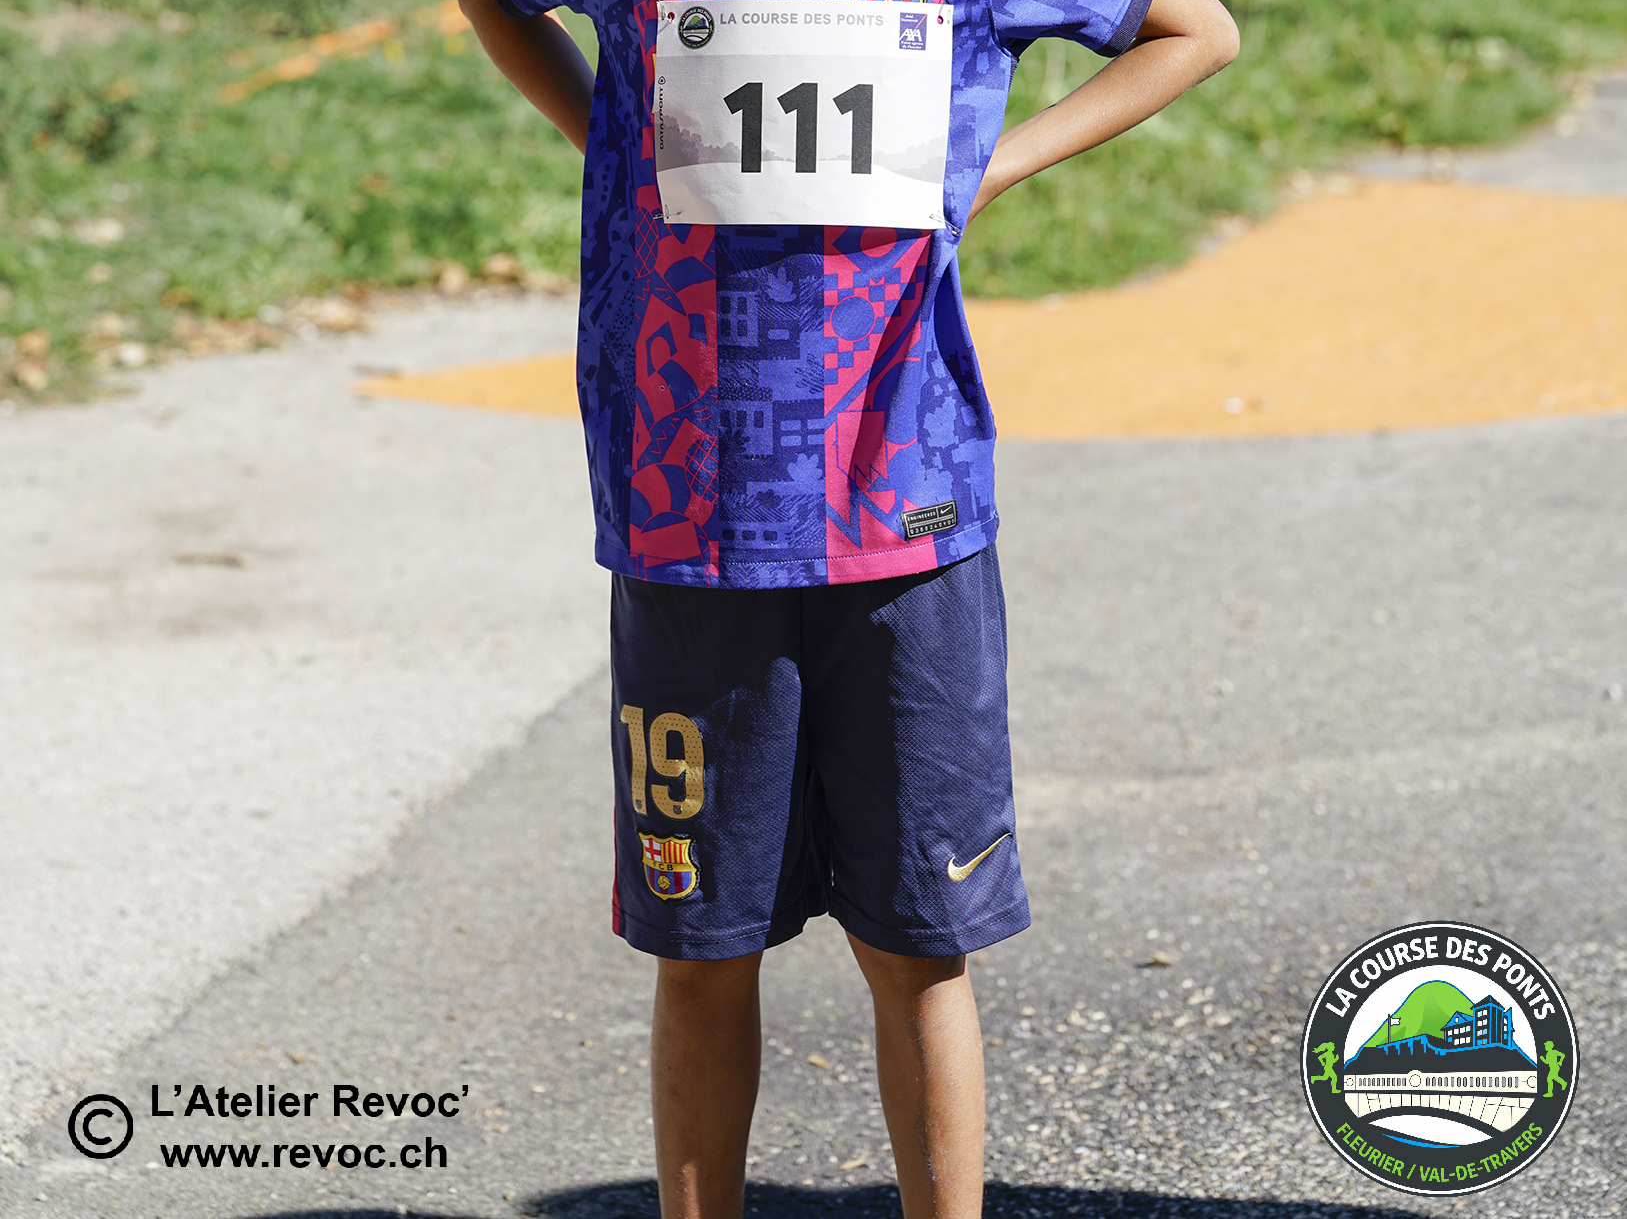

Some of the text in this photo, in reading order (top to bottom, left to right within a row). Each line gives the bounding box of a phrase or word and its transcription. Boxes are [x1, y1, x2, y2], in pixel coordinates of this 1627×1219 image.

[719, 12, 884, 27] LA COURSE DES PONTS
[900, 28, 923, 42] AXA
[723, 82, 874, 174] 111
[619, 704, 705, 819] 19
[652, 861, 674, 872] FCB
